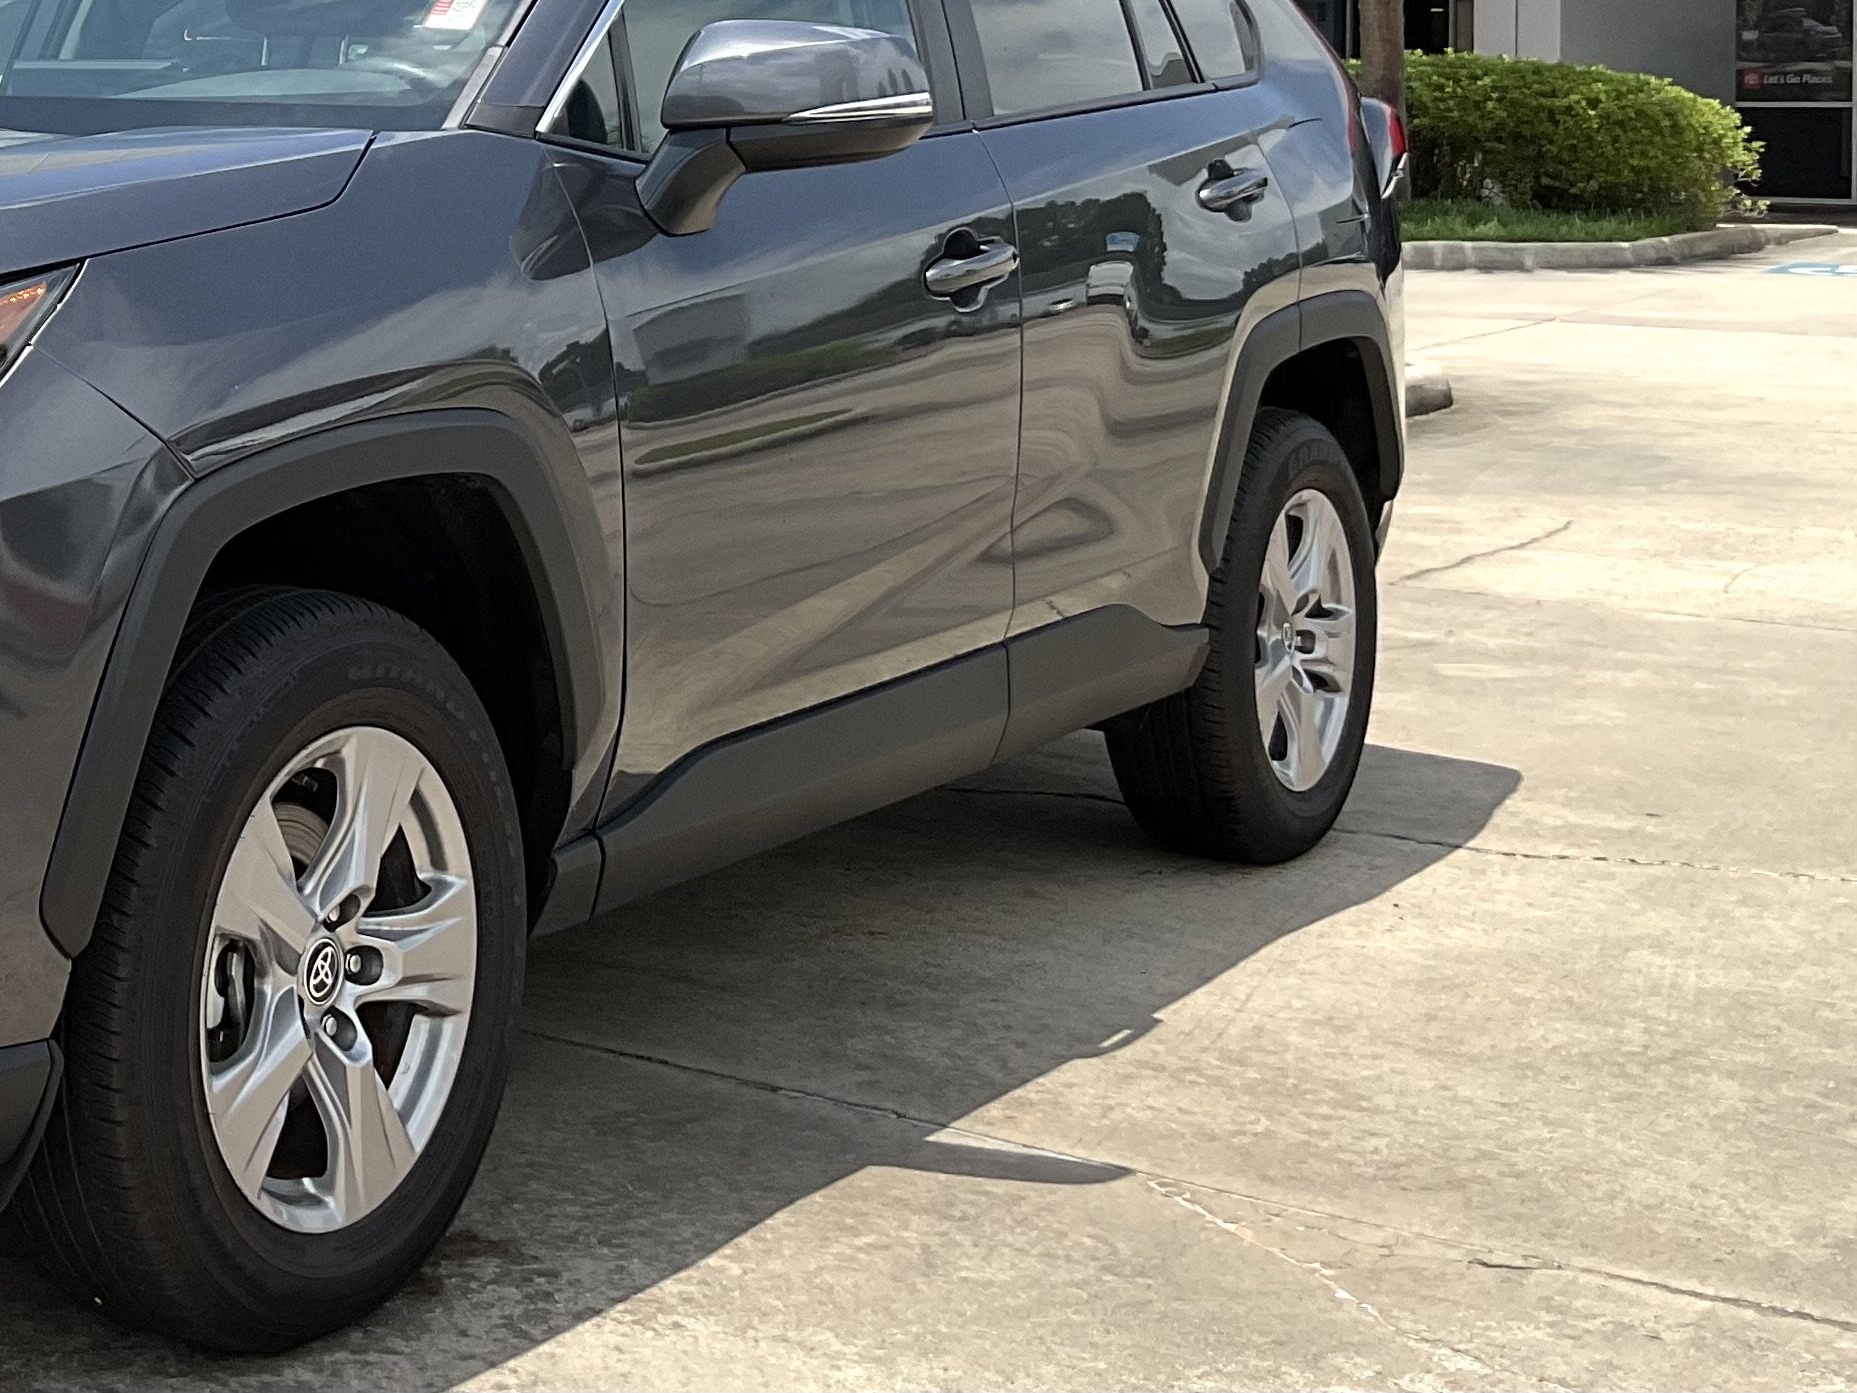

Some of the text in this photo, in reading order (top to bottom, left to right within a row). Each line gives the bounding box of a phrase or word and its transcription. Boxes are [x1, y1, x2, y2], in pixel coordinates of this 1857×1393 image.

[1763, 73, 1832, 84] Let's Go Places
